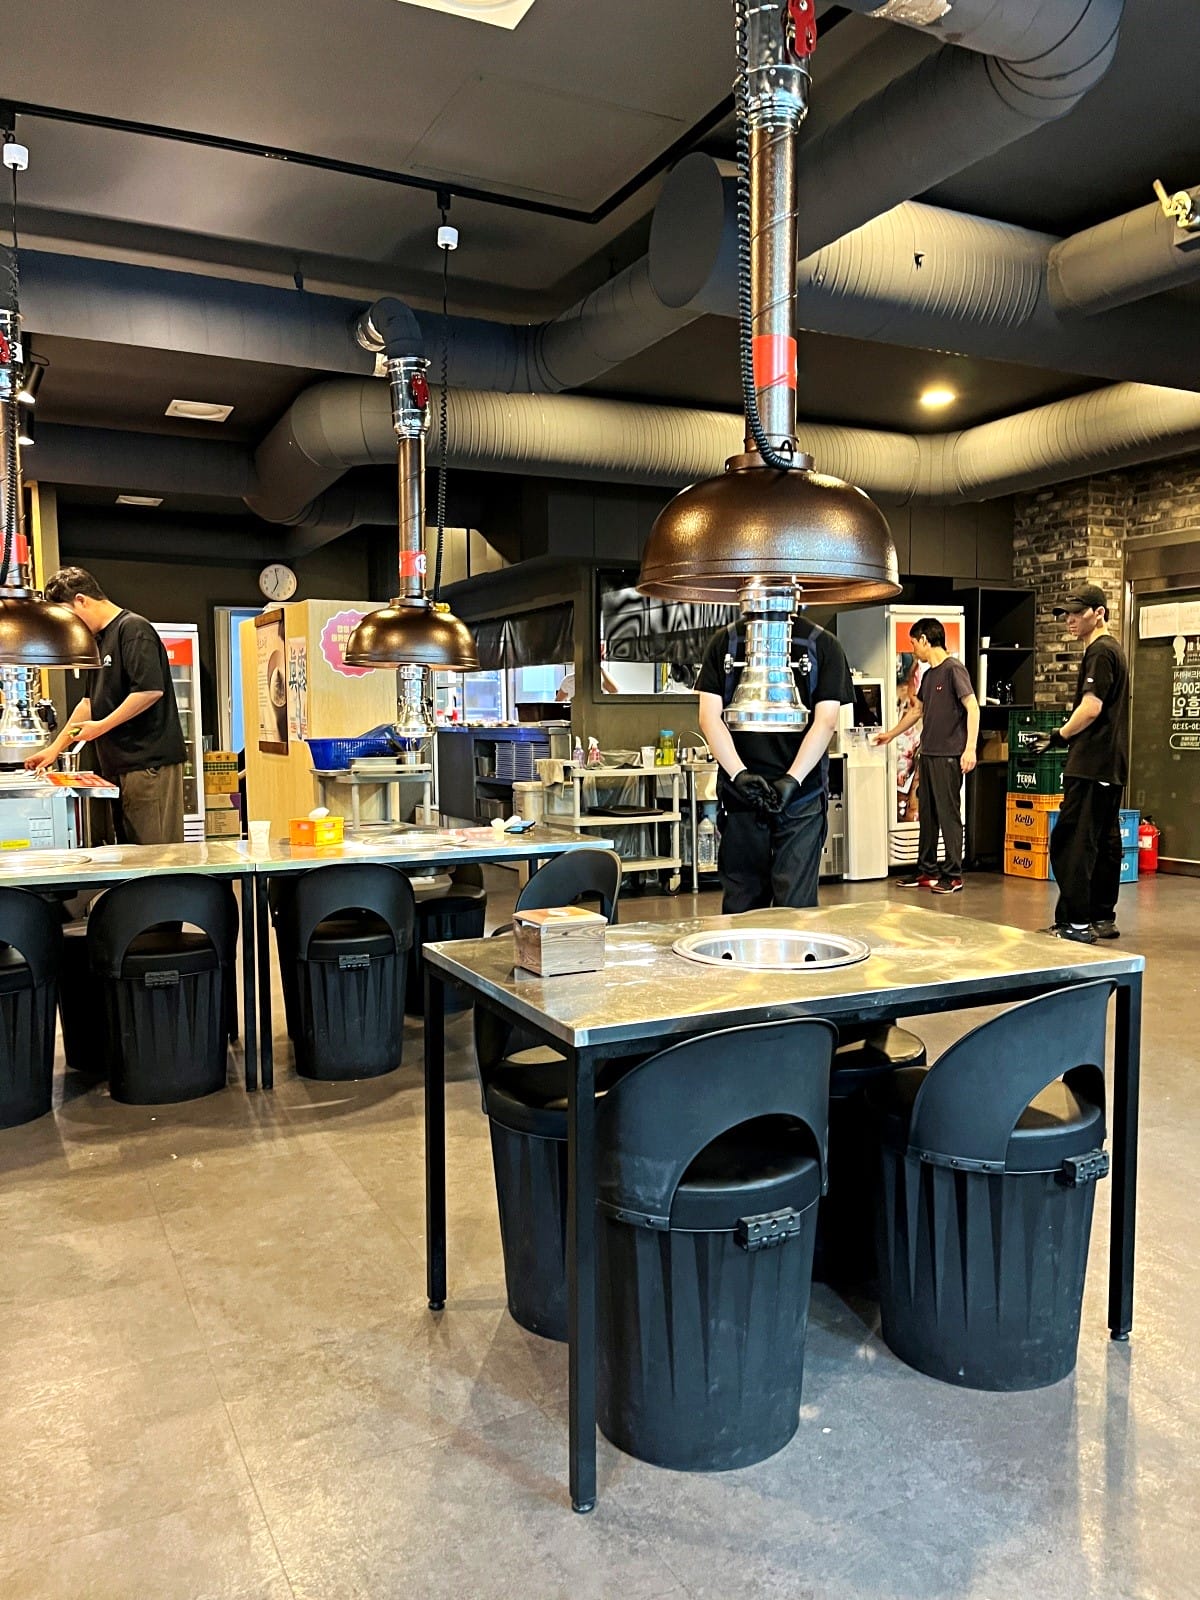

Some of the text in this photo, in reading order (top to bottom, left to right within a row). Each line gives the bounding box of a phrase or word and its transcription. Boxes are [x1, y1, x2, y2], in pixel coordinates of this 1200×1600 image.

[1016, 772, 1037, 785] TERRA
[1015, 813, 1035, 826] Kelly
[1013, 856, 1033, 869] Kelly
